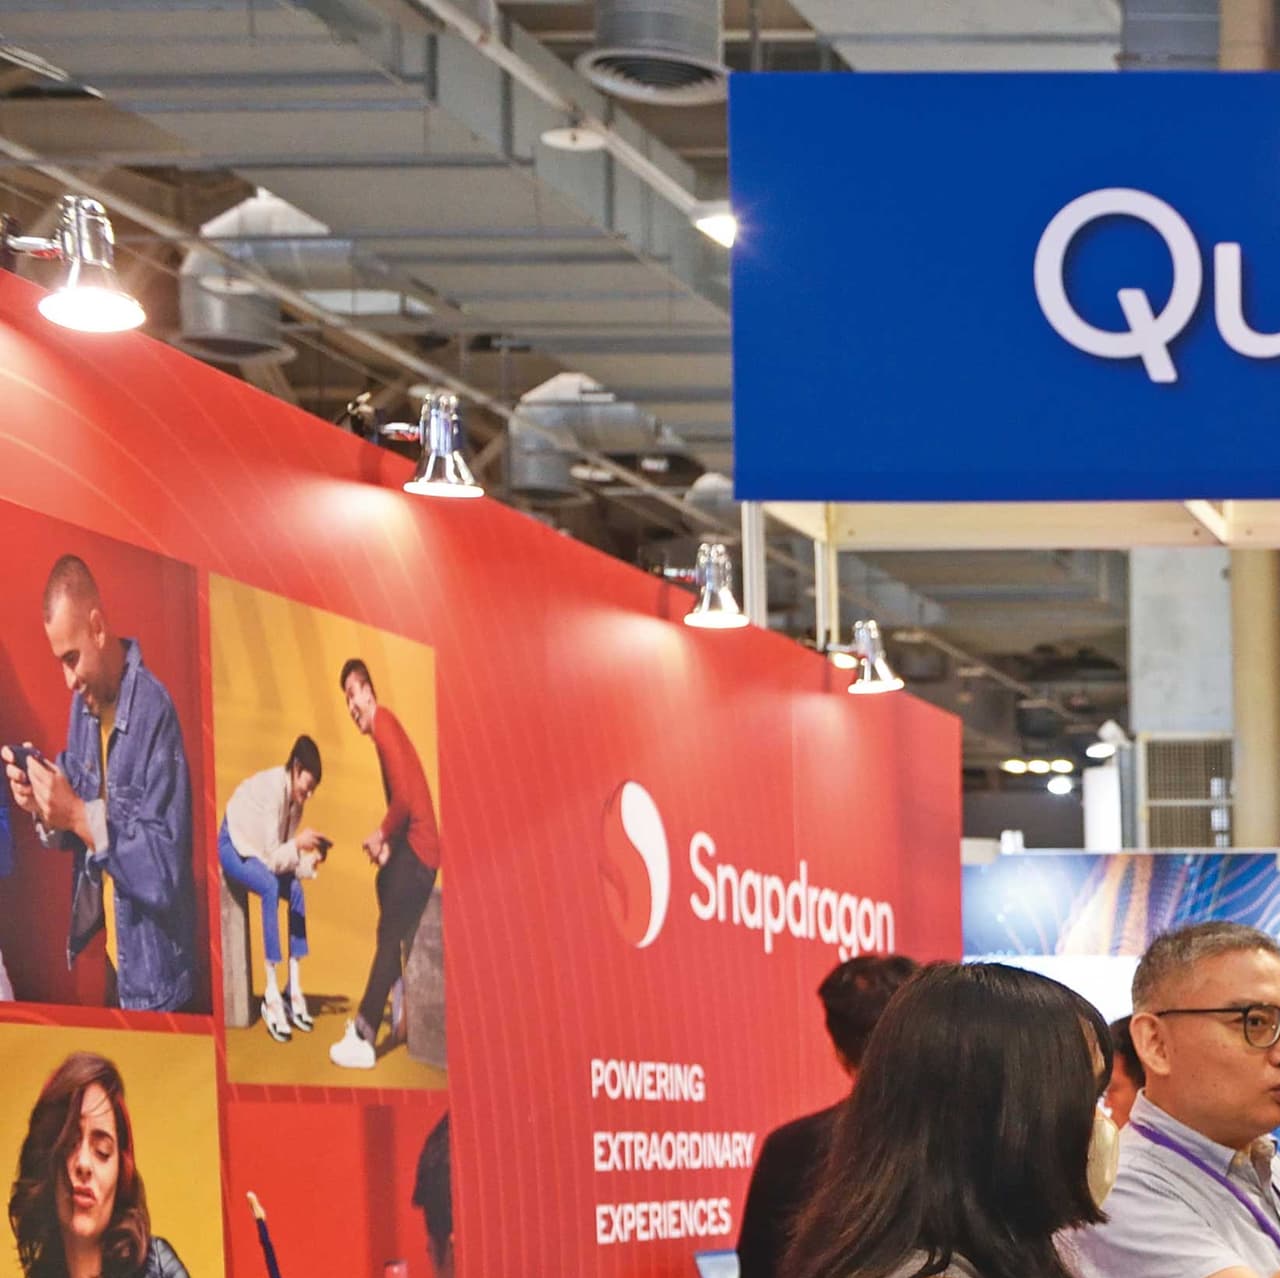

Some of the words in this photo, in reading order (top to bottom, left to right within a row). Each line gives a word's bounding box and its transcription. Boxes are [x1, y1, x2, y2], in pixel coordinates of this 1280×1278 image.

[689, 831, 896, 962] Snapdragon
[591, 1059, 706, 1102] POWERING
[593, 1131, 756, 1172] EXTRAORDINARY
[596, 1198, 732, 1244] EXPERIENCES
